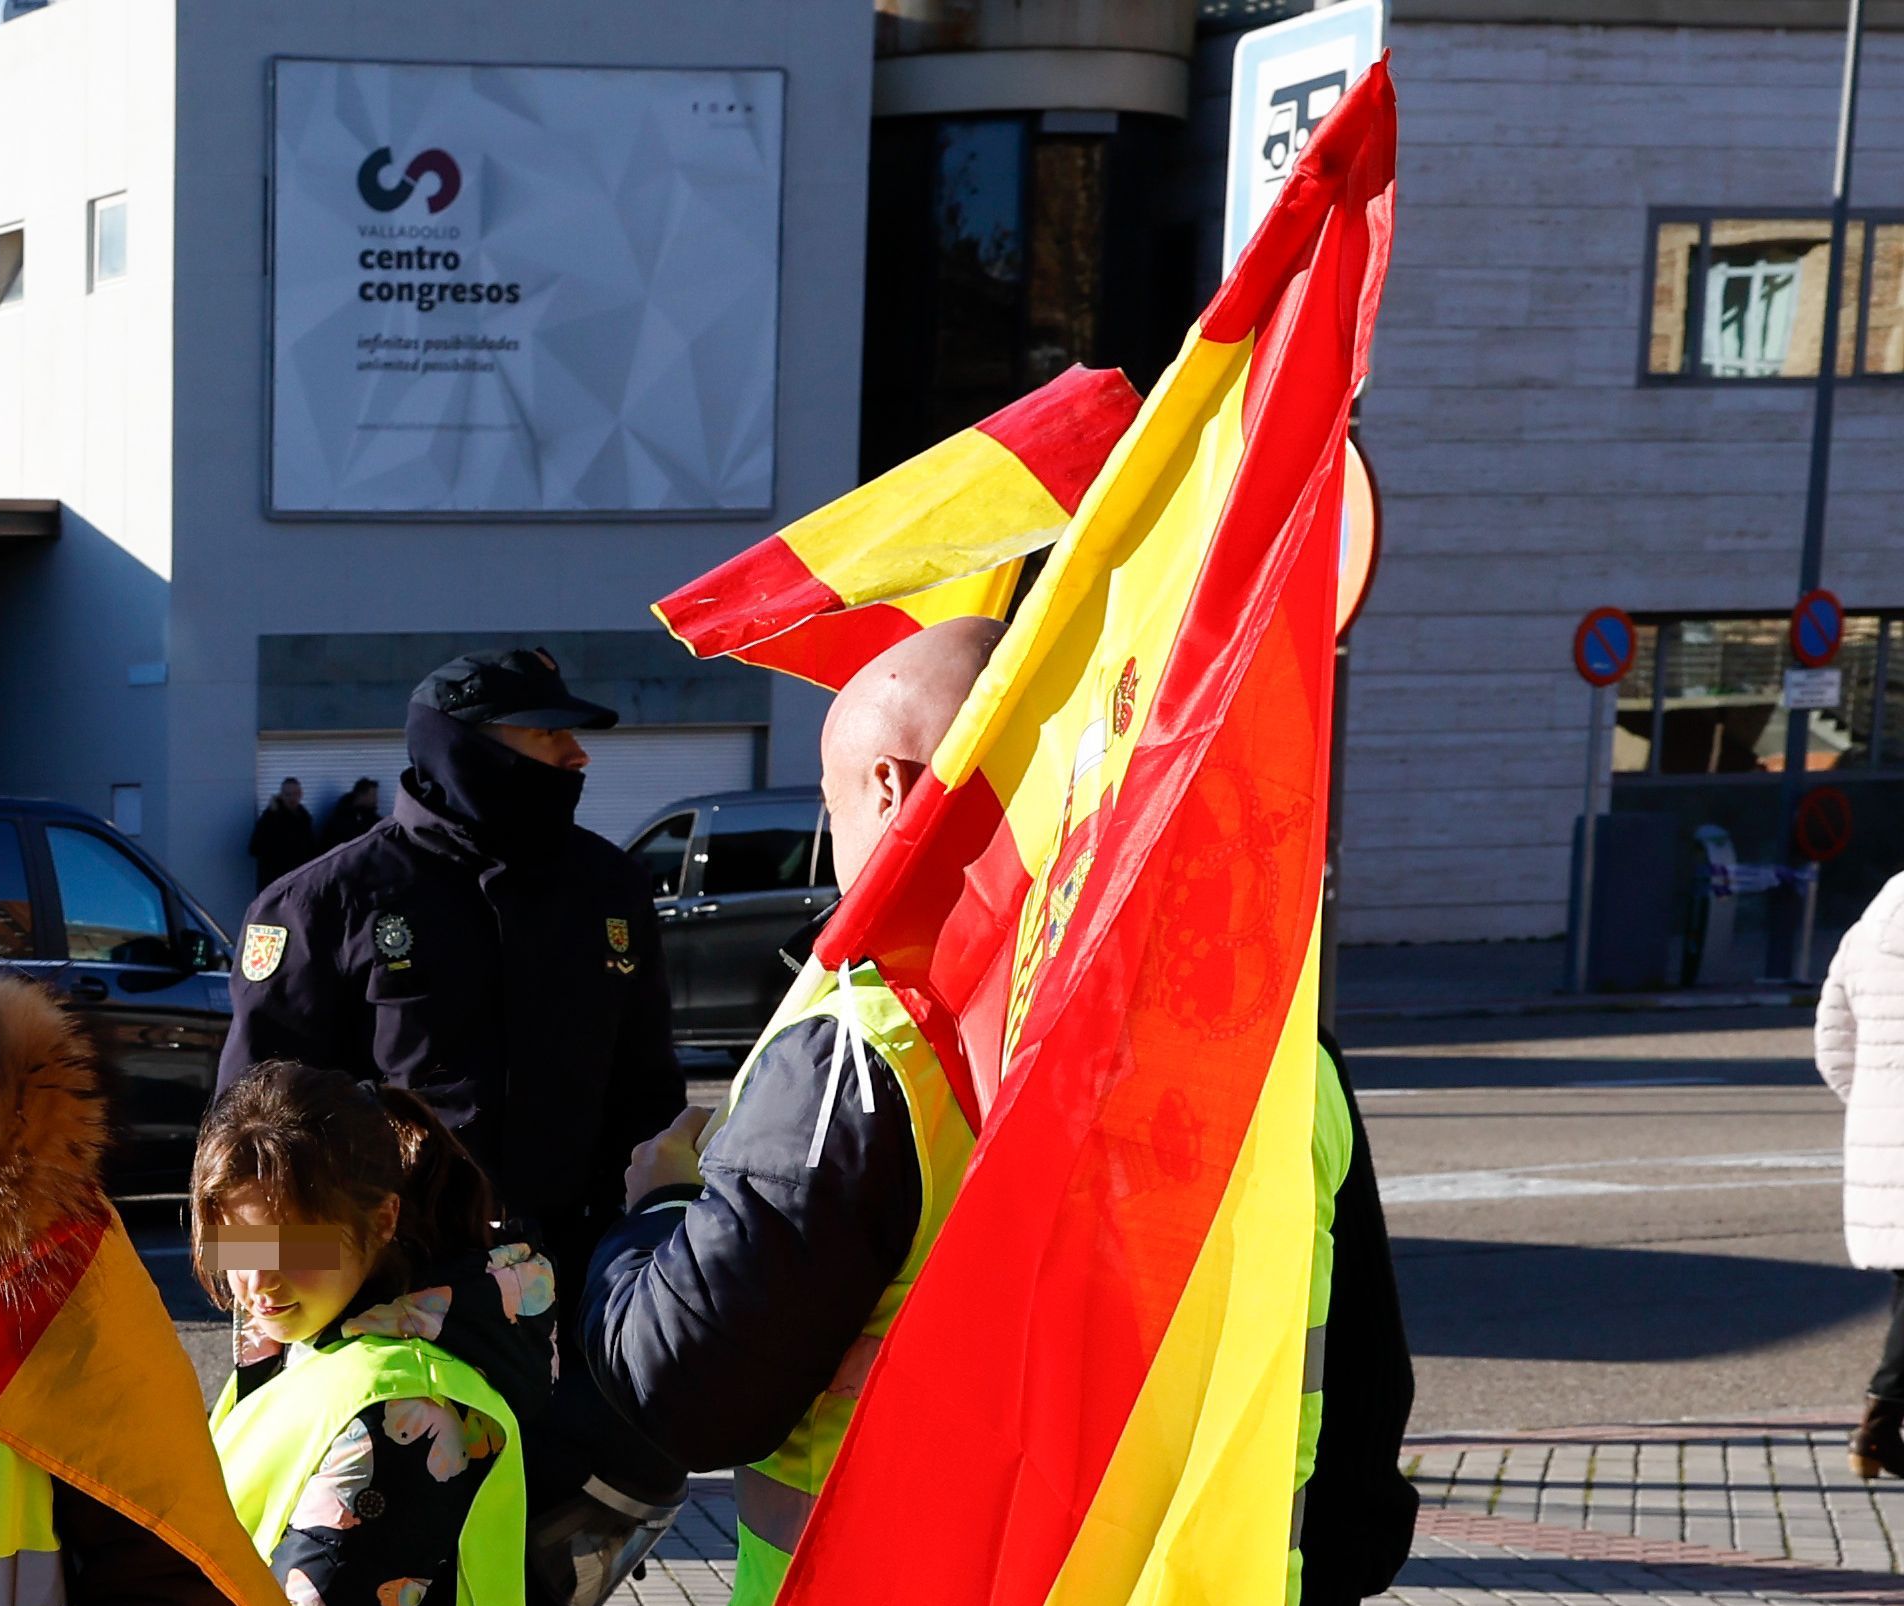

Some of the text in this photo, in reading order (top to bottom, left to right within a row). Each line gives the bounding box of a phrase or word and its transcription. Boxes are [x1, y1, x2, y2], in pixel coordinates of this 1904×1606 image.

[358, 225, 461, 239] VALLADOLID
[359, 245, 460, 271] centro
[359, 281, 521, 312] congresos
